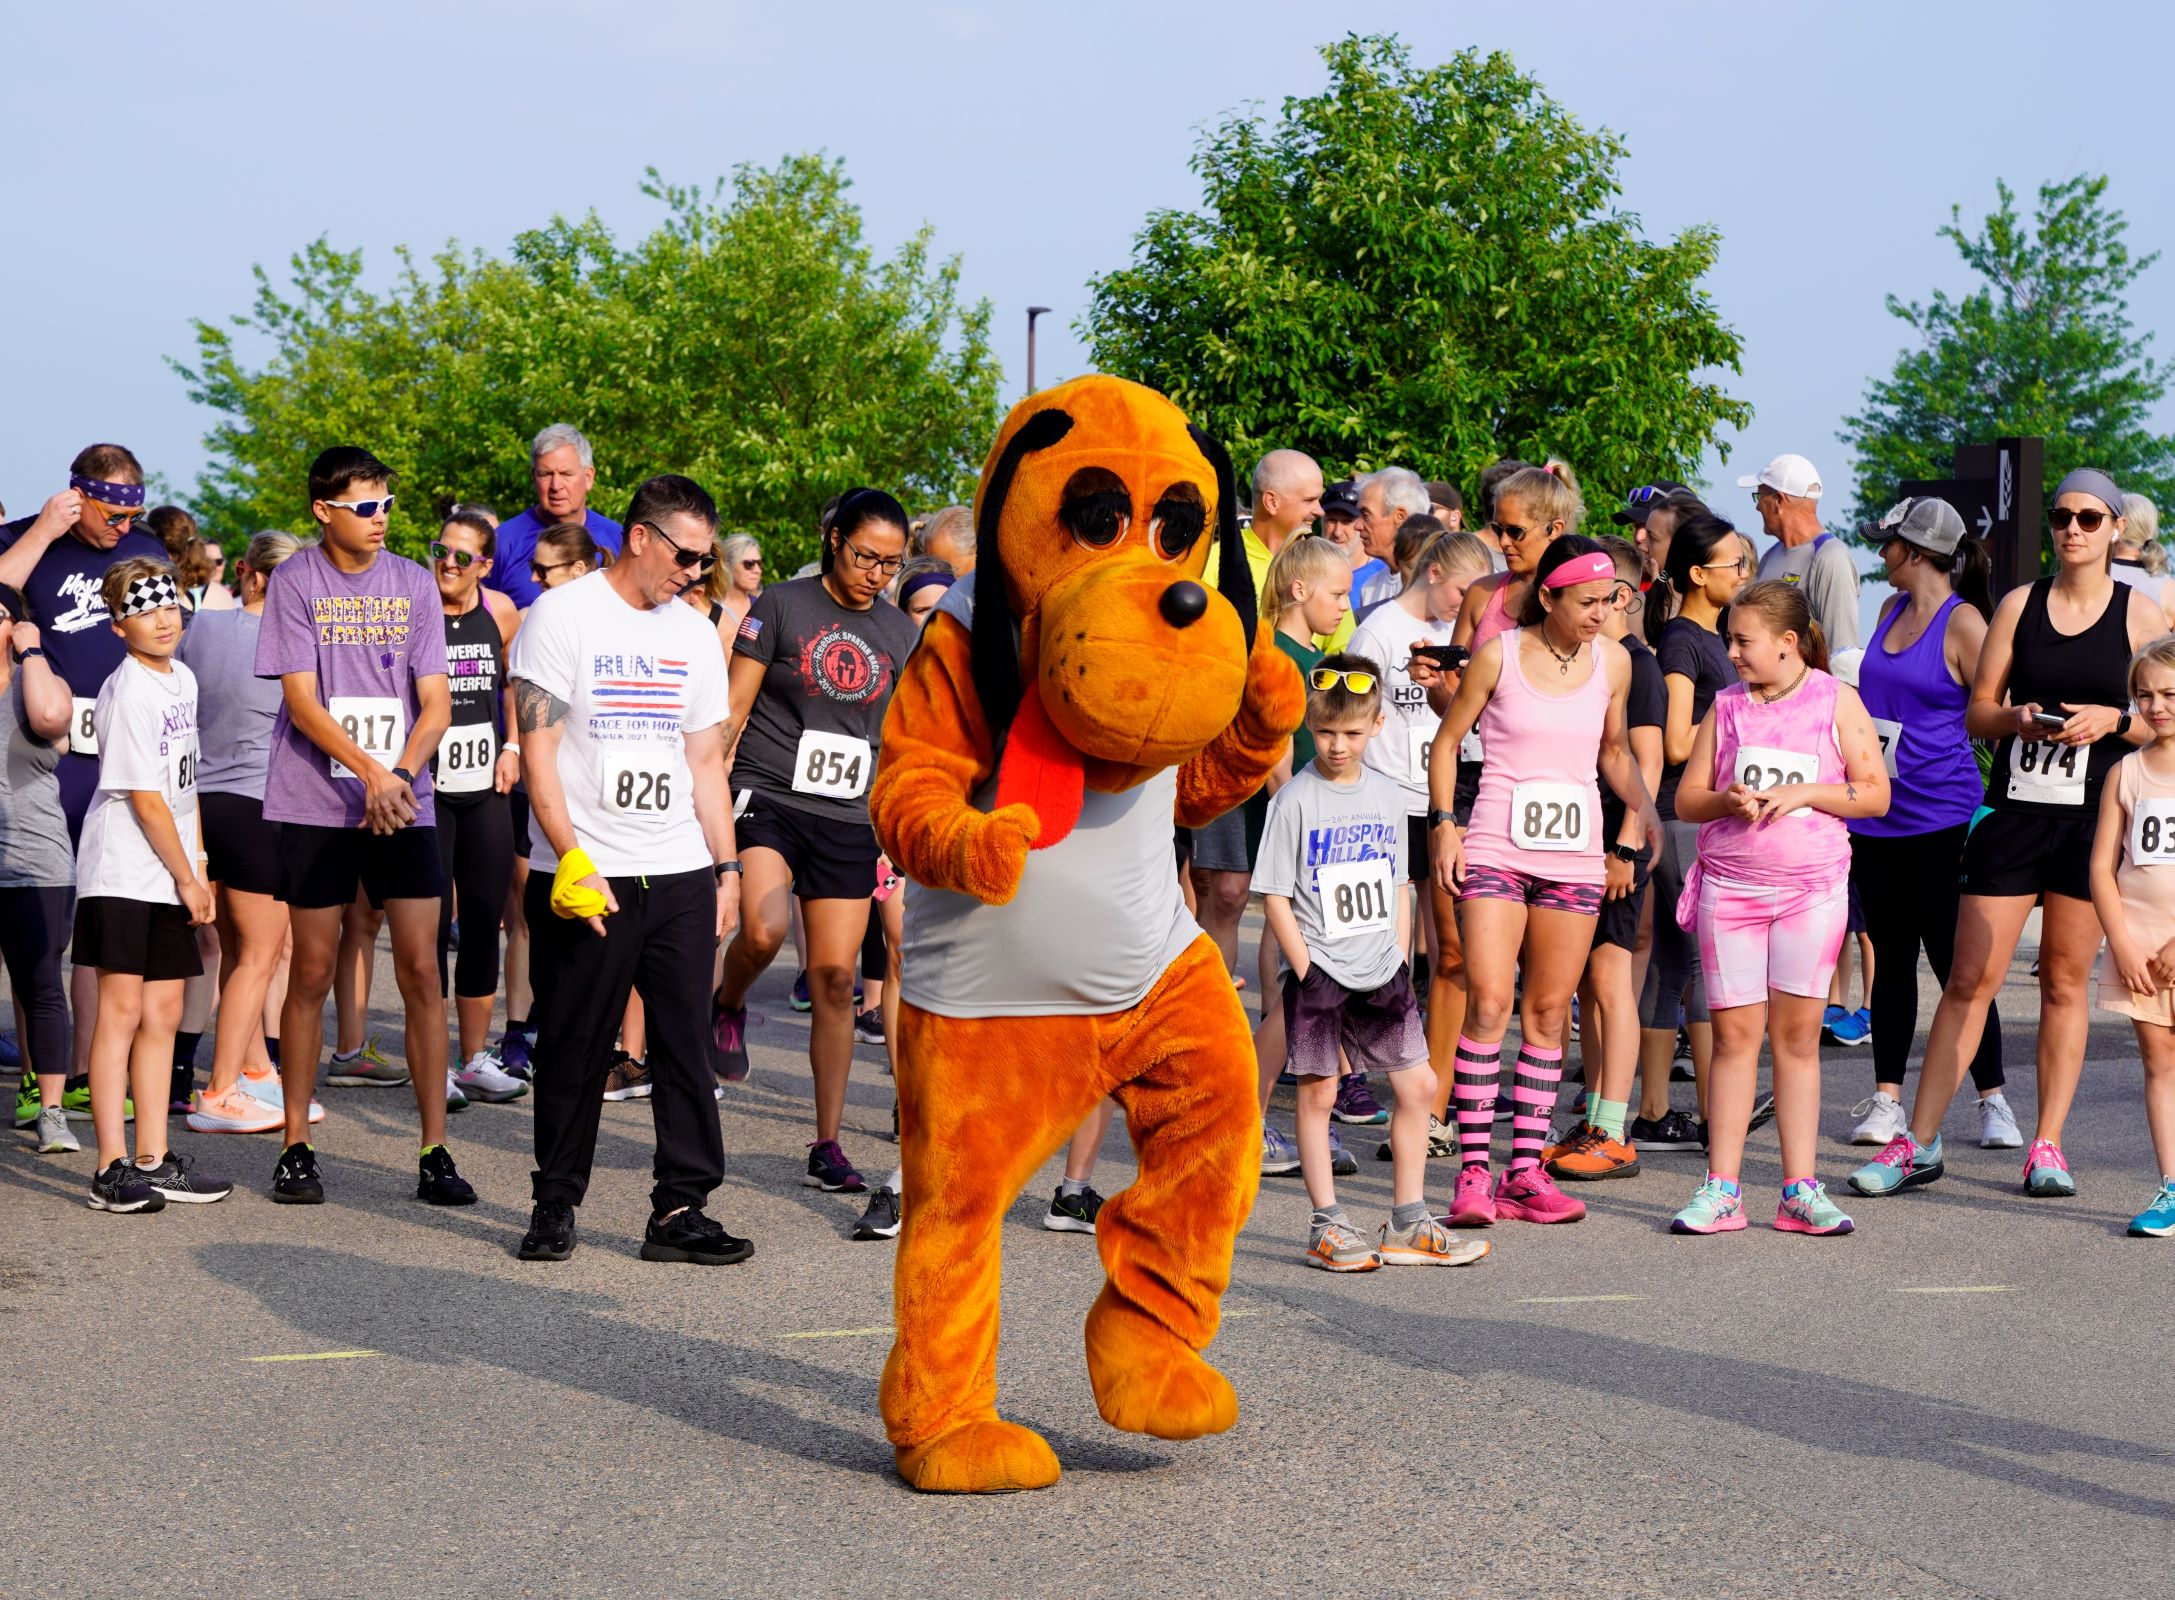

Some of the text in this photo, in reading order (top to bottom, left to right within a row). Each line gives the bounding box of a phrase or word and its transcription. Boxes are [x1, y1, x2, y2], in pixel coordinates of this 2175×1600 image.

[313, 596, 411, 624] WTERTOWN
[813, 631, 840, 660] Reebok
[842, 631, 873, 656] SPARTAN
[594, 654, 653, 678] RUN
[447, 676, 492, 692] WERFUL
[819, 678, 869, 701] 2016 SPRINT
[341, 714, 396, 751] 817
[589, 719, 683, 732] RACE FOR HOP
[448, 738, 489, 770] 818
[807, 748, 862, 789] 854
[2020, 740, 2077, 778] 874
[616, 769, 671, 811] 826
[1523, 801, 1580, 839] 820
[1334, 878, 1388, 924] 801
